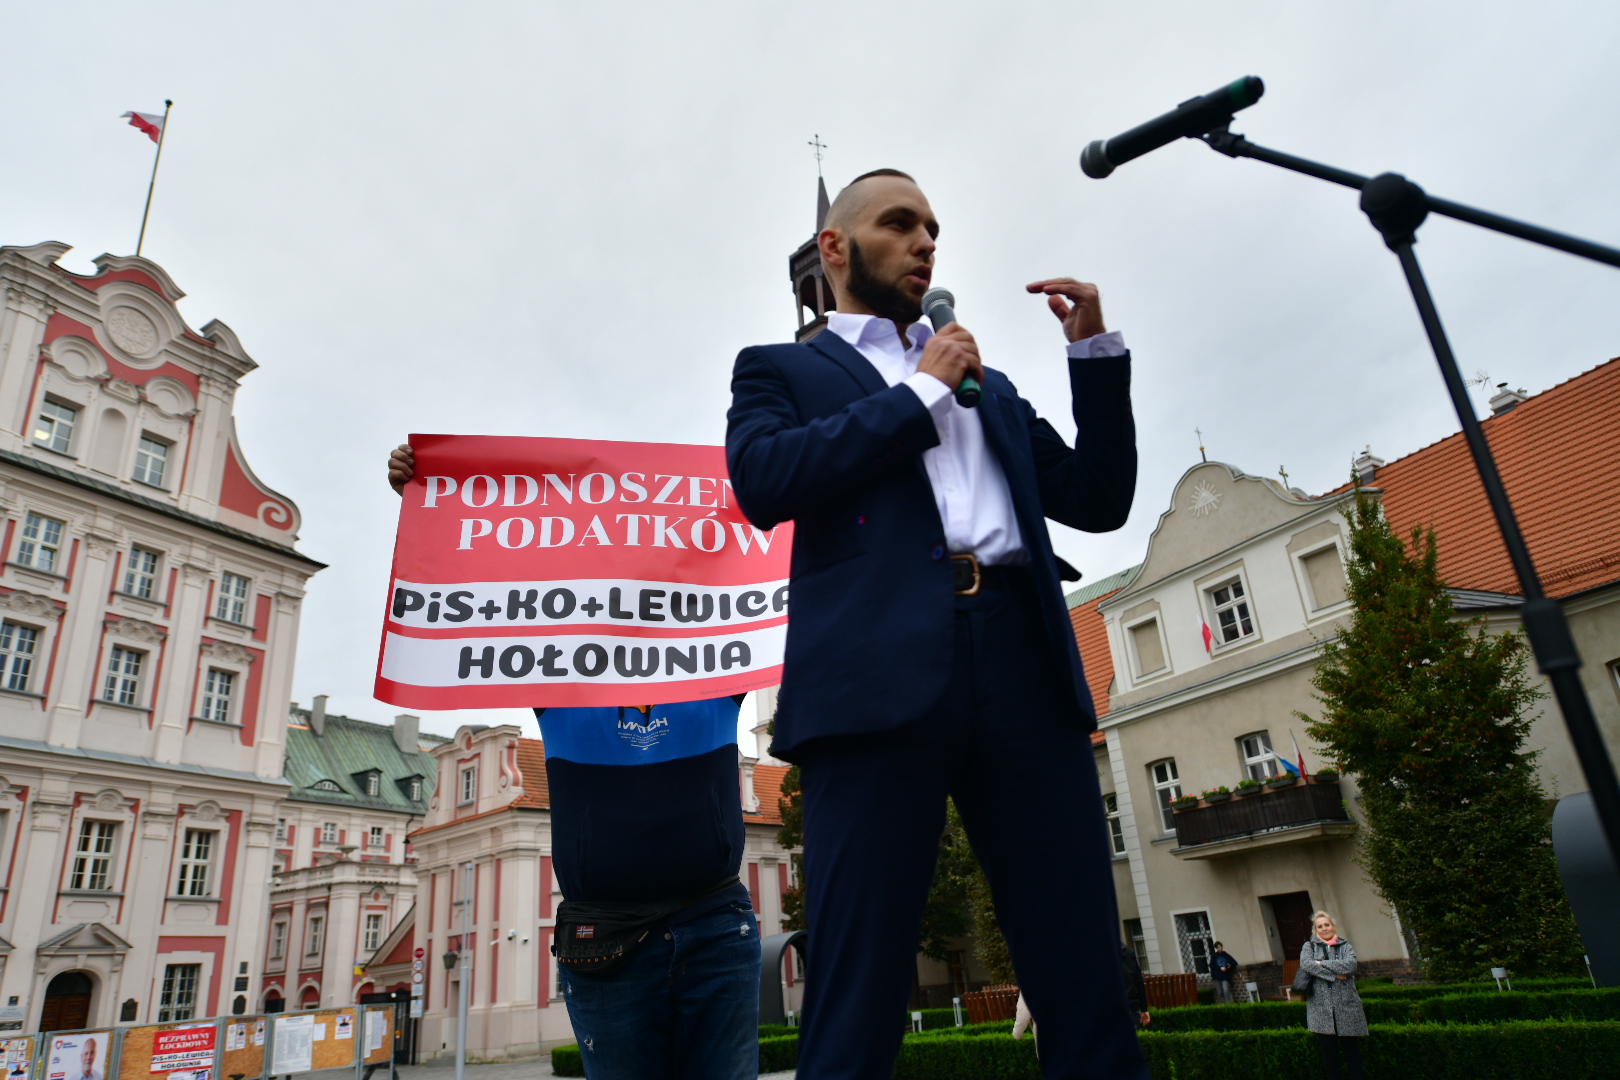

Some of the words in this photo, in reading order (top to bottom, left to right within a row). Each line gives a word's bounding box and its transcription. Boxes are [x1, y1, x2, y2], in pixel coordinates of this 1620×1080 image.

[456, 511, 778, 556] PODATKÓW
[458, 641, 751, 679] HOŁOWNIA
[159, 1033, 210, 1043] BEZPRAWNY
[160, 1040, 208, 1050] LOCKDOWN
[161, 1061, 201, 1069] HOŁOWNIA
